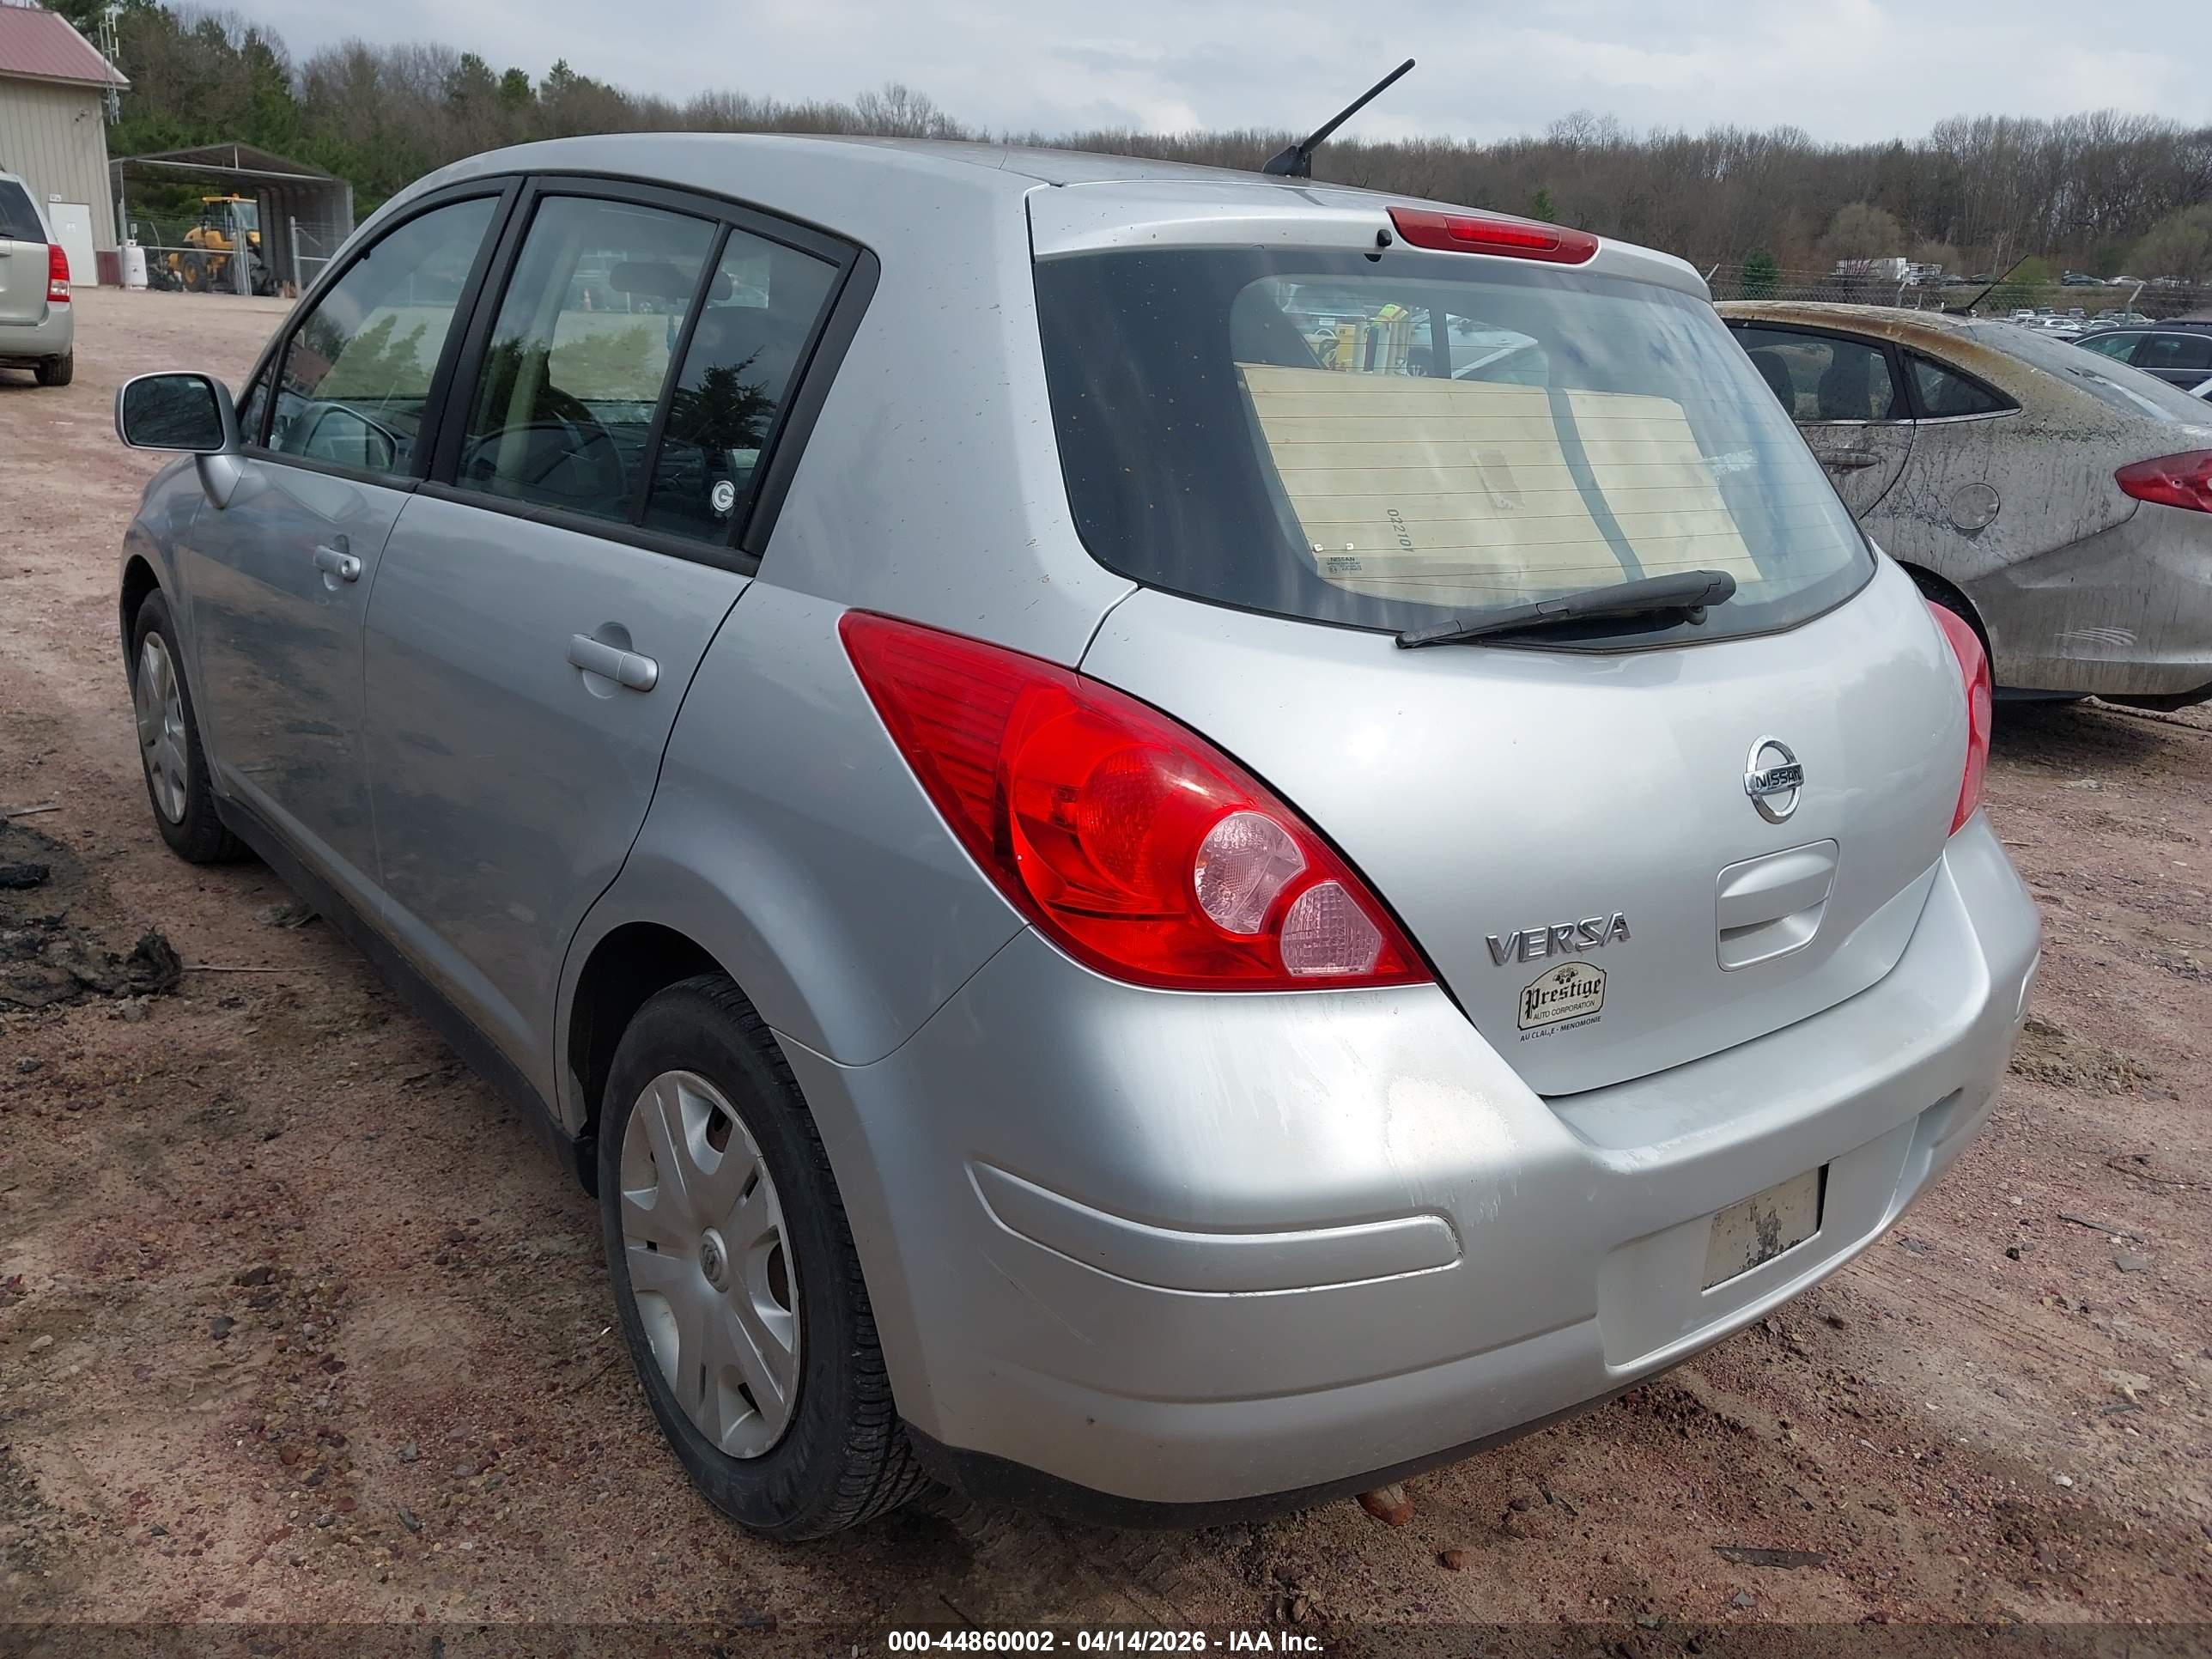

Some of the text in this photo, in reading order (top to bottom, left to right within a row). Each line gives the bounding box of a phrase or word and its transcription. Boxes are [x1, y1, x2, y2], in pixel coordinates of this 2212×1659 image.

[1755, 768, 1802, 788] NISSAN
[1486, 910, 1632, 967] VERSA
[1525, 978, 1601, 1020] Prestige
[1533, 1000, 1595, 1021] AUTO CORPORATION
[1559, 1016, 1602, 1032] MENOMONIE
